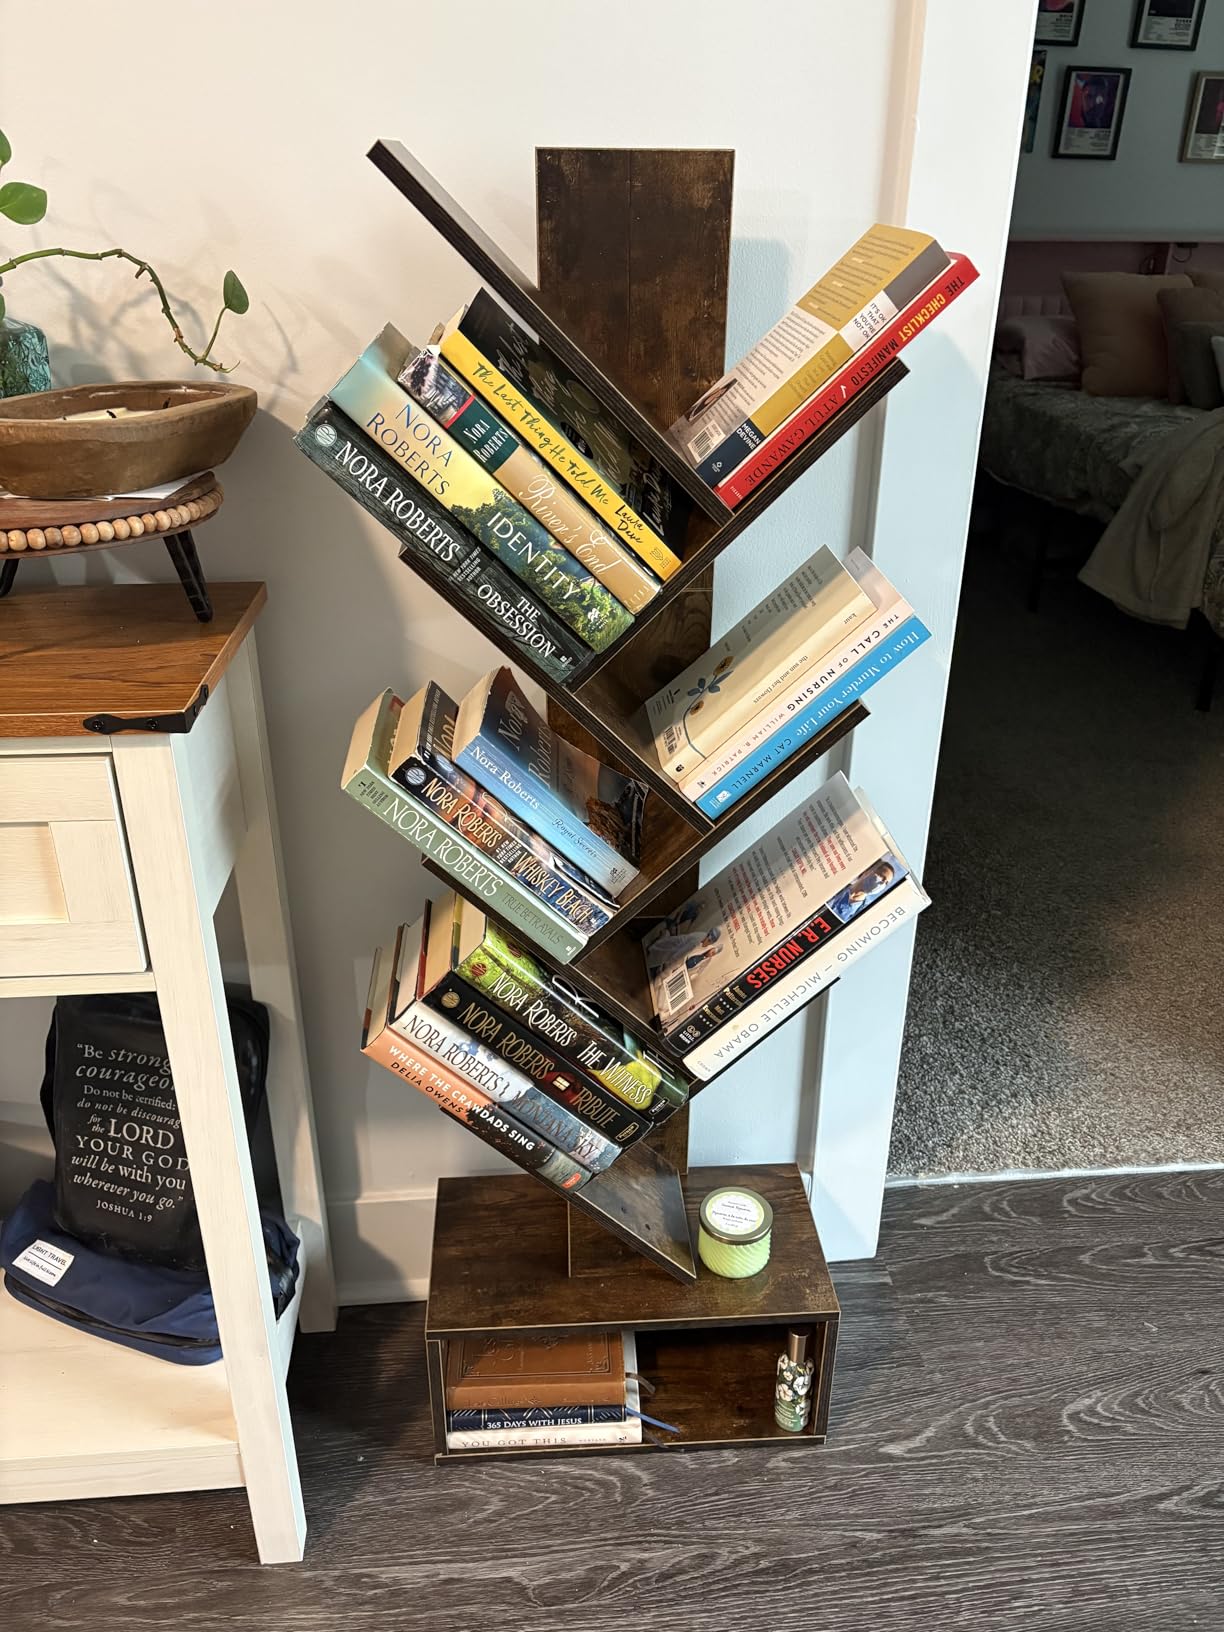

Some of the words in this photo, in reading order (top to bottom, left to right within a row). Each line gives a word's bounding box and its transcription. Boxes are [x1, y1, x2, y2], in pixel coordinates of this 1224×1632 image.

[945, 276, 965, 297] THE
[860, 312, 877, 334] YOU'RE
[867, 311, 880, 325] THAT
[870, 302, 880, 315] IT'S
[878, 313, 887, 323] OK
[899, 293, 947, 342] CHECKLIST
[853, 318, 864, 330] NOT
[862, 330, 871, 339] OK
[851, 338, 900, 387] MANIFESTO
[805, 394, 839, 426] ATUL
[395, 403, 453, 467] NORA
[463, 418, 491, 444] NORA
[472, 362, 495, 387] The
[493, 384, 524, 412] Last
[519, 409, 553, 449] Thing
[549, 445, 566, 463] He
[566, 460, 590, 489] Told
[590, 484, 609, 505] Me
[736, 428, 757, 450] DEVINE
[742, 423, 760, 445] MEGAN
[366, 412, 450, 496] ROBERTS
[472, 427, 509, 463] ROBERTS
[744, 427, 805, 485] GAWANDE
[335, 441, 388, 498] NORA
[385, 488, 460, 561] ROBERTS
[518, 473, 582, 544] River's
[576, 529, 622, 575] End
[614, 504, 645, 531] Laura
[617, 519, 643, 544] Dave
[487, 512, 581, 600] IDENTITY
[477, 584, 556, 657] OBSESSION
[516, 596, 541, 623] THE
[844, 612, 858, 625] kaur
[882, 613, 900, 629] THE
[850, 630, 881, 655] CALL
[892, 631, 920, 652] How
[789, 662, 800, 672] sun
[799, 655, 809, 664] the
[838, 657, 849, 668] OF
[879, 652, 893, 664] to
[772, 677, 782, 688] her
[780, 670, 791, 679] and
[841, 665, 881, 698] Murder
[752, 687, 773, 705] flowers
[786, 668, 836, 712] NURSING
[818, 697, 844, 719] Your
[751, 713, 785, 741] WILLIAM
[796, 716, 819, 736] Life
[775, 738, 792, 755] CAT
[711, 749, 743, 776] PATRICK
[731, 754, 773, 790] MARNELL
[470, 746, 498, 775] Nora
[499, 770, 541, 810] Roberts
[421, 778, 459, 814] NORA
[453, 803, 502, 848] ROBERTS
[552, 818, 575, 840] Royal
[573, 837, 597, 859] Secrets
[383, 797, 438, 849] NORA
[434, 837, 504, 897] ROBERTS
[502, 894, 523, 916] TRUE
[520, 910, 562, 945] BETRAYALS
[512, 852, 565, 898] WHISKEY
[555, 889, 594, 923] BEACH
[798, 916, 832, 943] E.R.
[837, 906, 906, 962] BECOMING
[746, 938, 804, 989] NURSES
[760, 971, 822, 1023] MICHELLE
[488, 971, 529, 1011] NORA
[522, 999, 578, 1047] ROBERTS
[577, 1040, 607, 1070] THE
[600, 1056, 652, 1105] WITNESS
[714, 1023, 759, 1058] OBAMA
[75, 1065, 175, 1091] courageo
[403, 1014, 447, 1052] NORA
[442, 1042, 504, 1092] ROBERTS
[511, 1090, 574, 1144] MONTANA
[457, 1002, 503, 1043] NORA
[496, 1031, 555, 1080] ROBERTS
[569, 1086, 621, 1129] TRIBUTE
[83, 1084, 100, 1095] Do
[102, 1089, 121, 1099] not
[121, 1089, 133, 1101] be
[136, 1095, 176, 1110] terrified:
[388, 1045, 429, 1076] WHERE
[428, 1073, 451, 1093] THE
[451, 1090, 510, 1133] CRAWDADS
[508, 1129, 536, 1151] SING
[390, 1061, 422, 1086] DELIA
[425, 1086, 465, 1113] OWENS
[77, 1098, 91, 1108] do
[94, 1101, 114, 1112] not
[116, 1103, 128, 1114] be
[87, 1114, 102, 1125] for
[91, 1124, 105, 1133] the
[108, 1118, 175, 1150] LORD
[75, 1135, 134, 1160] YOUR
[142, 1151, 190, 1171] GOD
[71, 1154, 99, 1169] will
[100, 1158, 116, 1173] be
[118, 1164, 152, 1183] with
[155, 1175, 186, 1190] you
[73, 1172, 130, 1196] wherever
[129, 1190, 155, 1204] you
[96, 1199, 135, 1218] JOSHUA
[138, 1212, 153, 1222] 1:9
[32, 1244, 49, 1256] LIGHT
[48, 1252, 67, 1266] TRAVEL
[486, 1421, 502, 1430] 365
[503, 1419, 527, 1429] DAYS
[529, 1418, 556, 1427] WITH
[557, 1417, 583, 1426] JESUS
[461, 1440, 491, 1448] YOU
[497, 1438, 527, 1446] GOT
[534, 1437, 568, 1445] THIS
